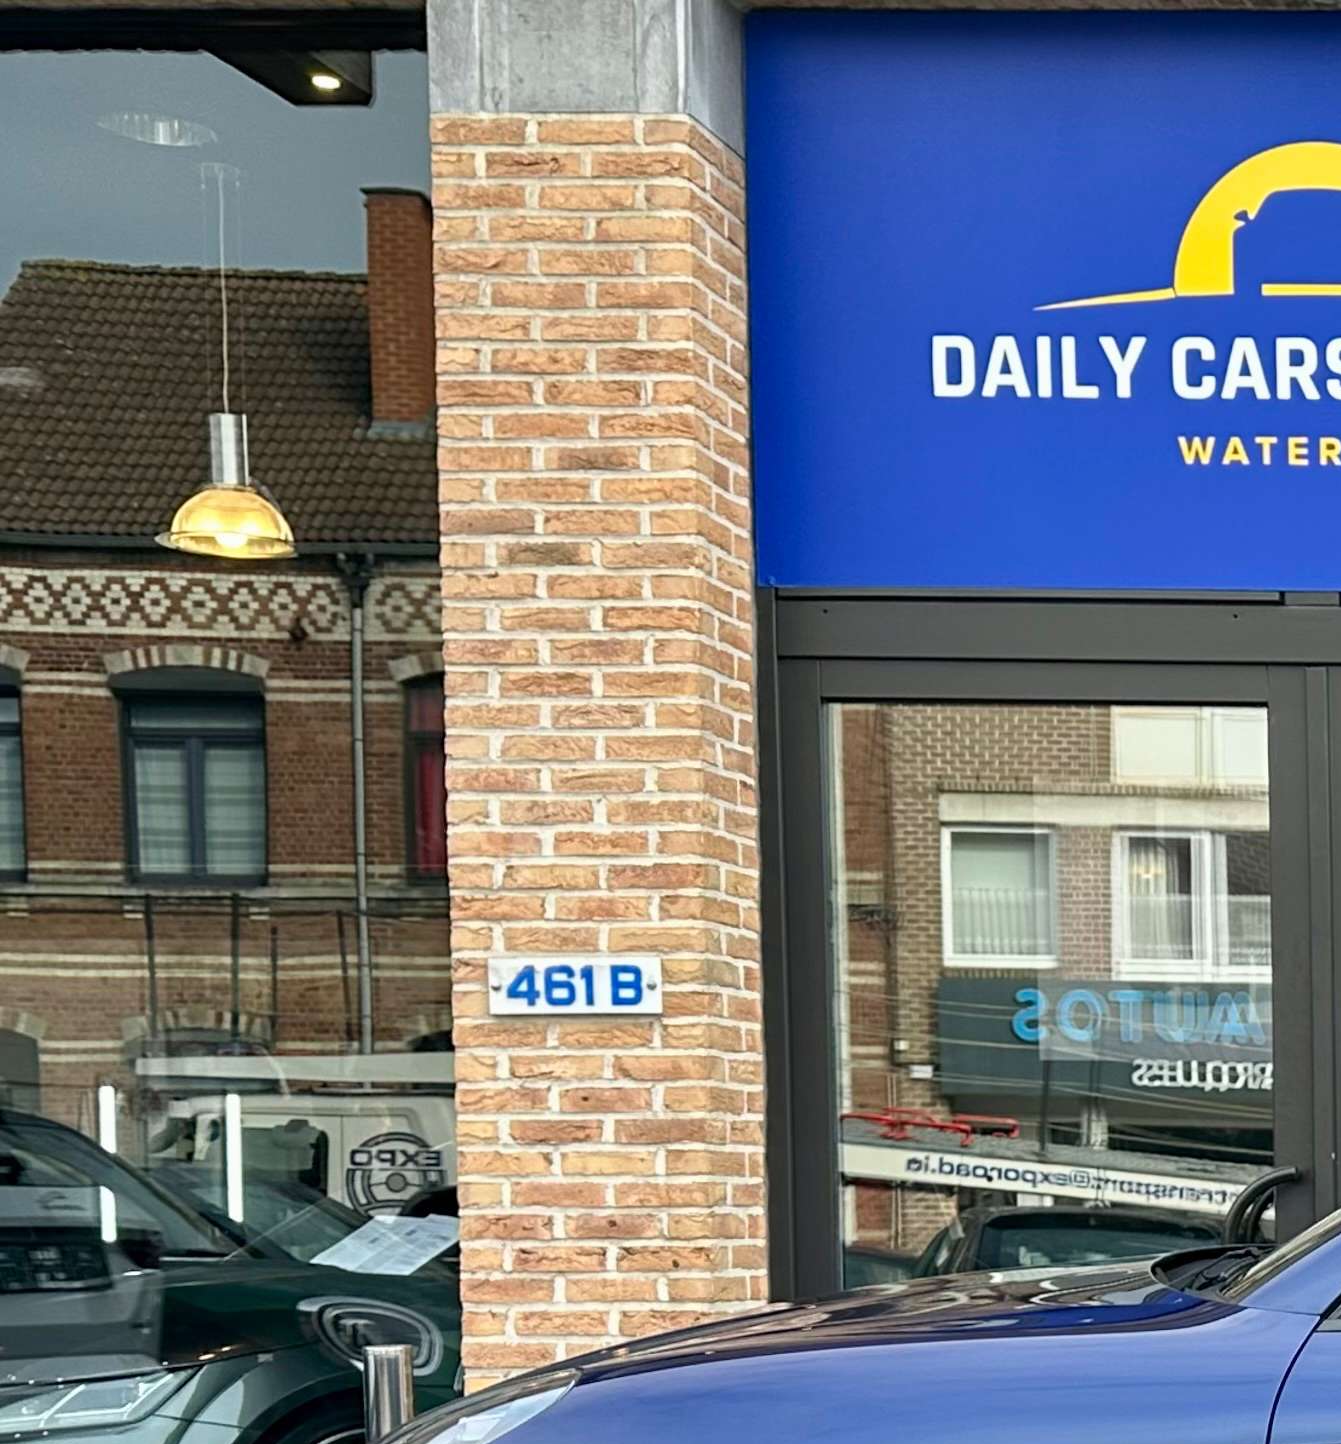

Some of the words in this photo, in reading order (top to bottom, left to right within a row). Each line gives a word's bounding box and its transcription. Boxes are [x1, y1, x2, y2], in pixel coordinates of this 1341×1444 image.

[931, 334, 1147, 399] DAILY
[507, 964, 595, 1006] 461
[609, 964, 643, 1006] B
